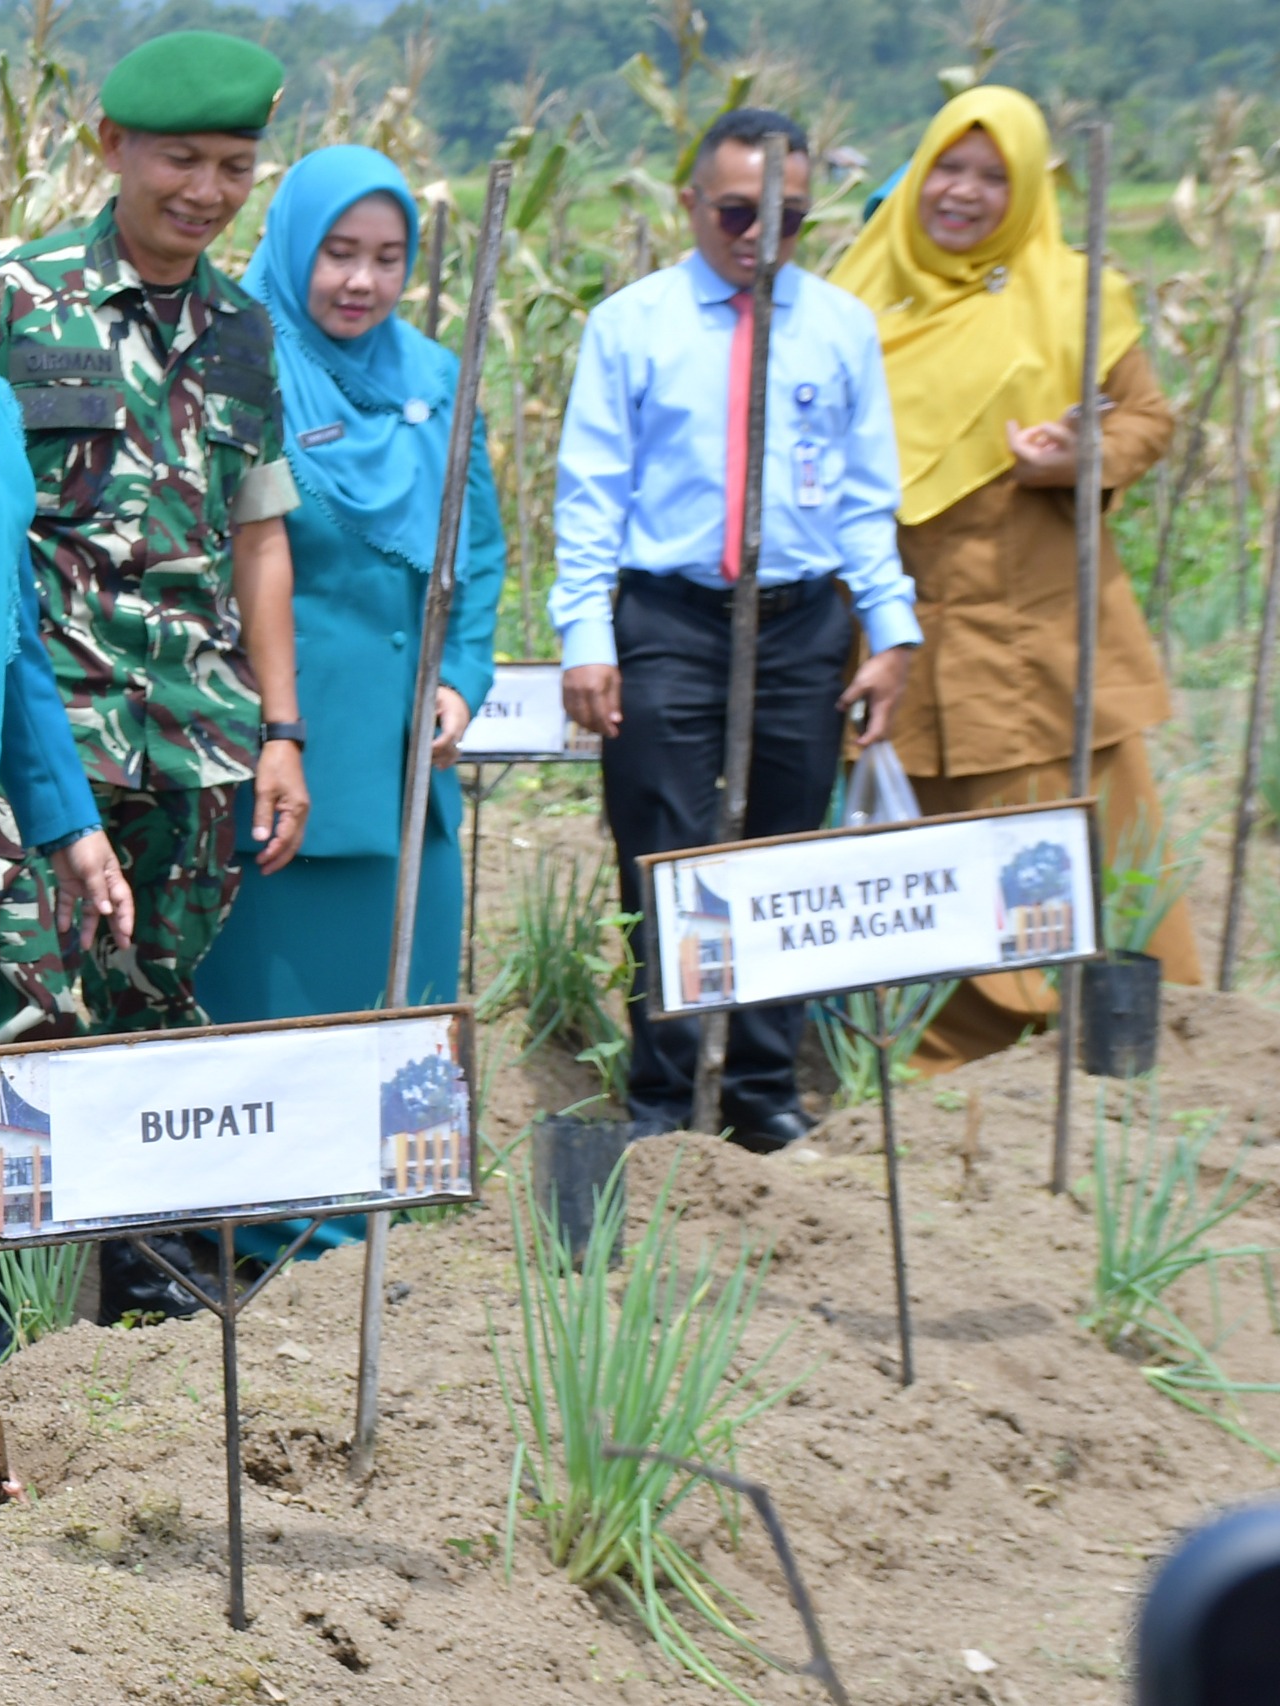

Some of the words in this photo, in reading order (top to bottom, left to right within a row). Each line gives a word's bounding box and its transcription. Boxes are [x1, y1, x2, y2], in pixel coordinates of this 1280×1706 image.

[751, 885, 845, 921] KETUA
[857, 878, 892, 905] TP
[904, 868, 958, 898] PKK
[780, 920, 837, 951] KAB
[850, 905, 935, 940] AGAM
[141, 1102, 275, 1143] BUPATI
